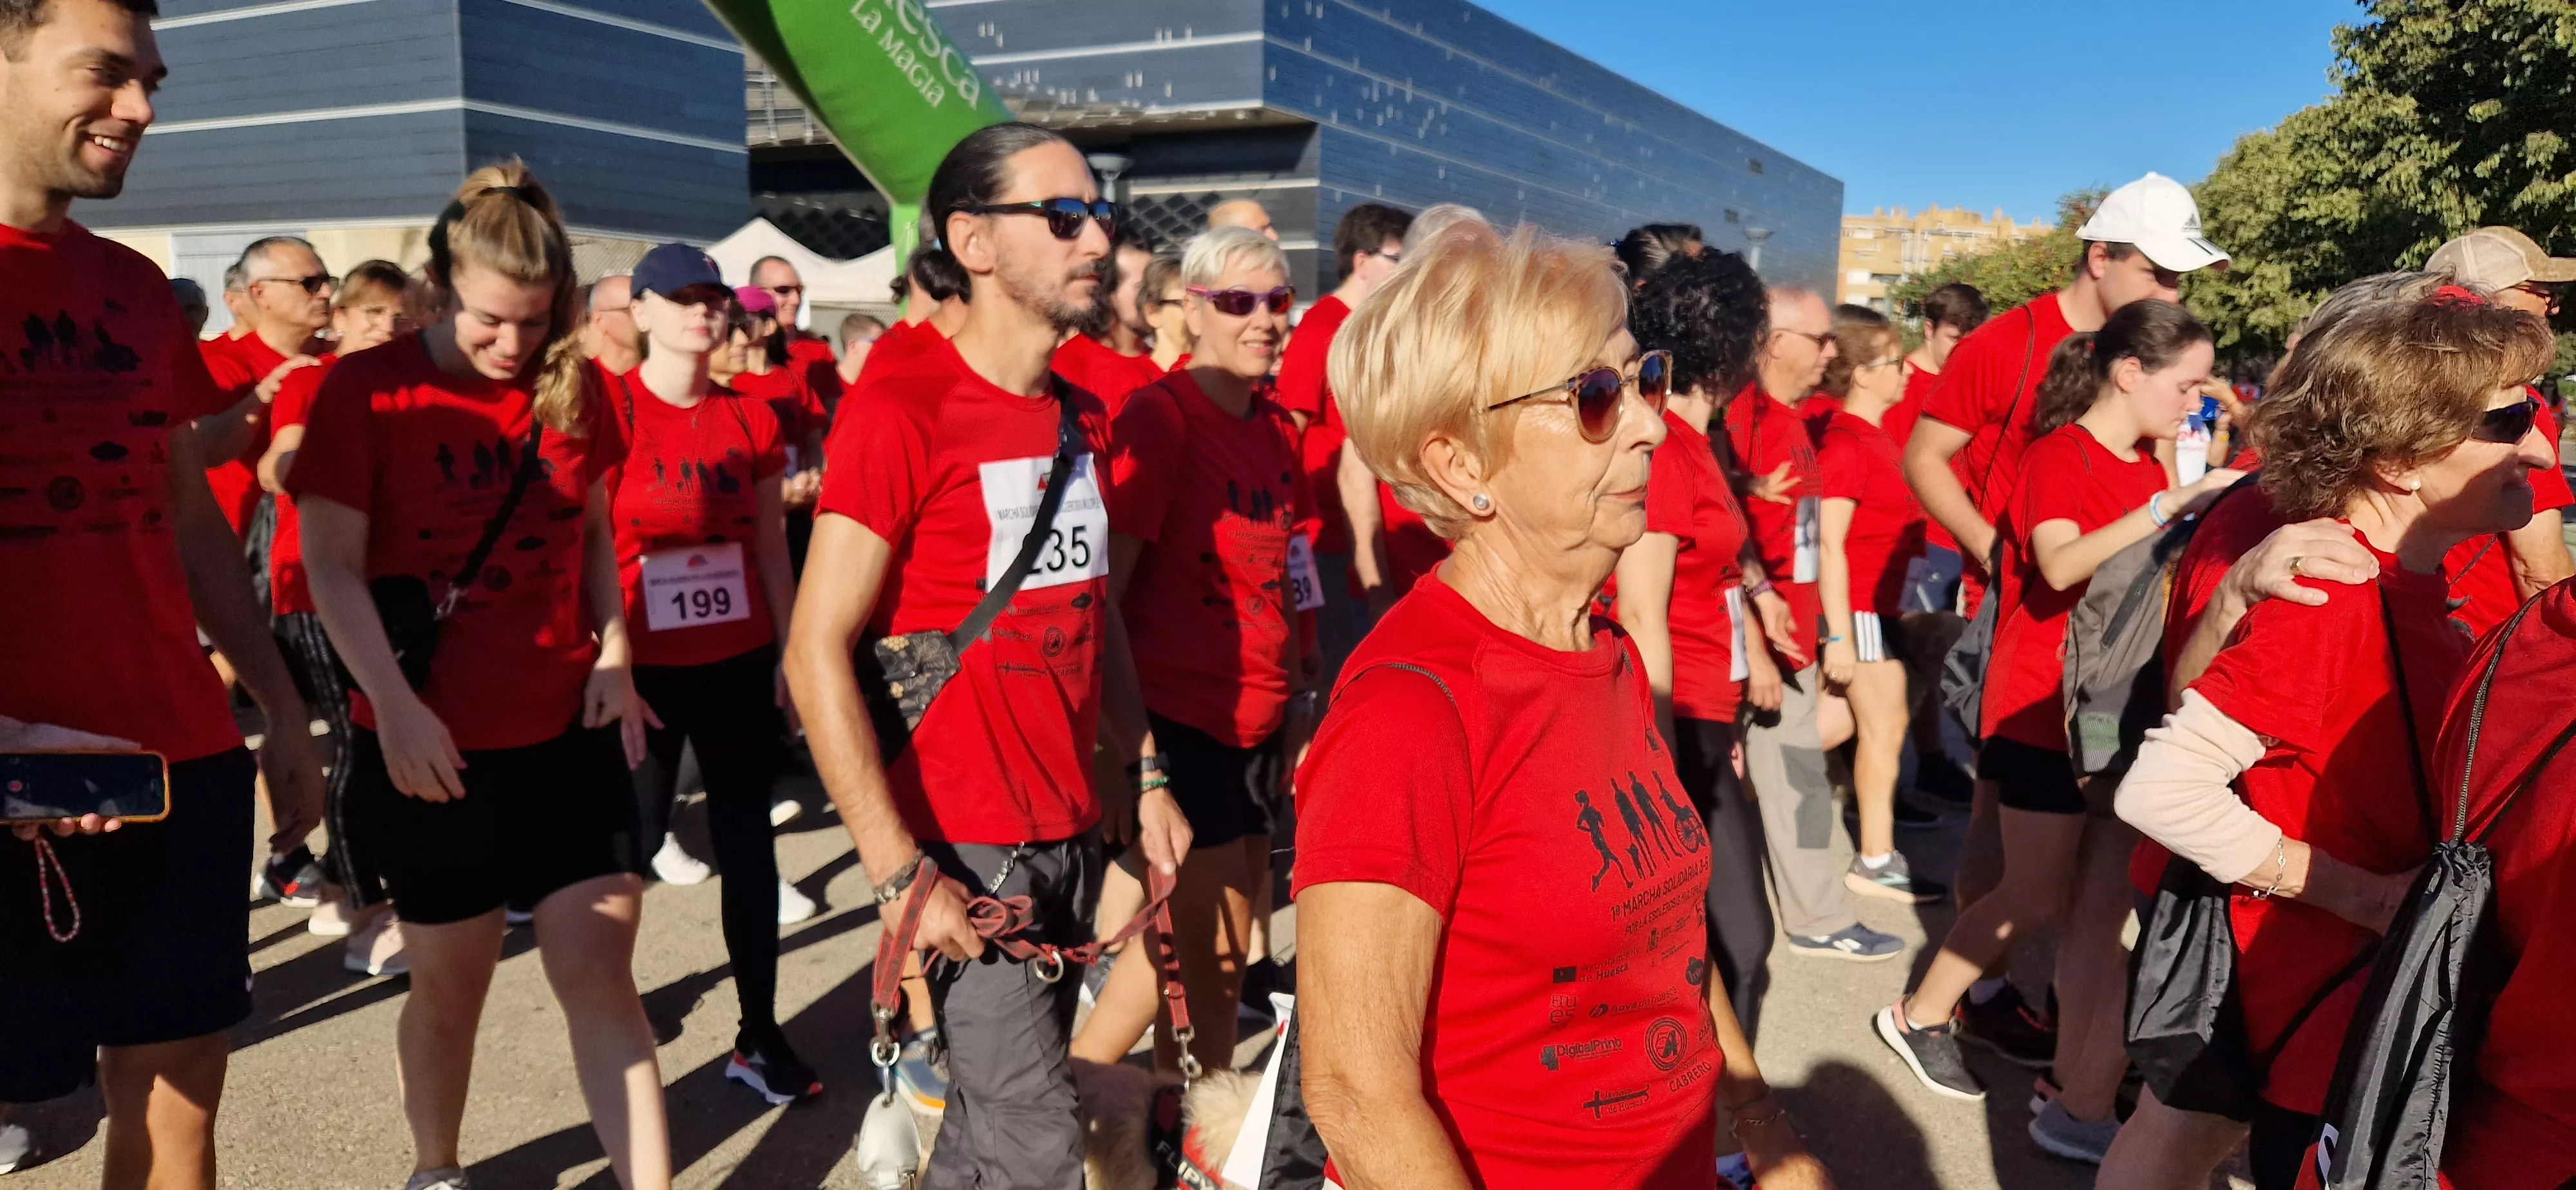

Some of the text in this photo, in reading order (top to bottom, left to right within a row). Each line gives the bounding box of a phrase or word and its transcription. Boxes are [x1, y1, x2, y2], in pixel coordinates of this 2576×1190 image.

[885, 0, 980, 110] esca
[672, 587, 730, 621] 199
[1623, 883, 1661, 917] MARCHA
[1663, 862, 1698, 895] SOLIDARIA
[1624, 921, 1639, 936] POR
[1596, 963, 1629, 980] Huesca
[1669, 1061, 1712, 1092] CABRERO
